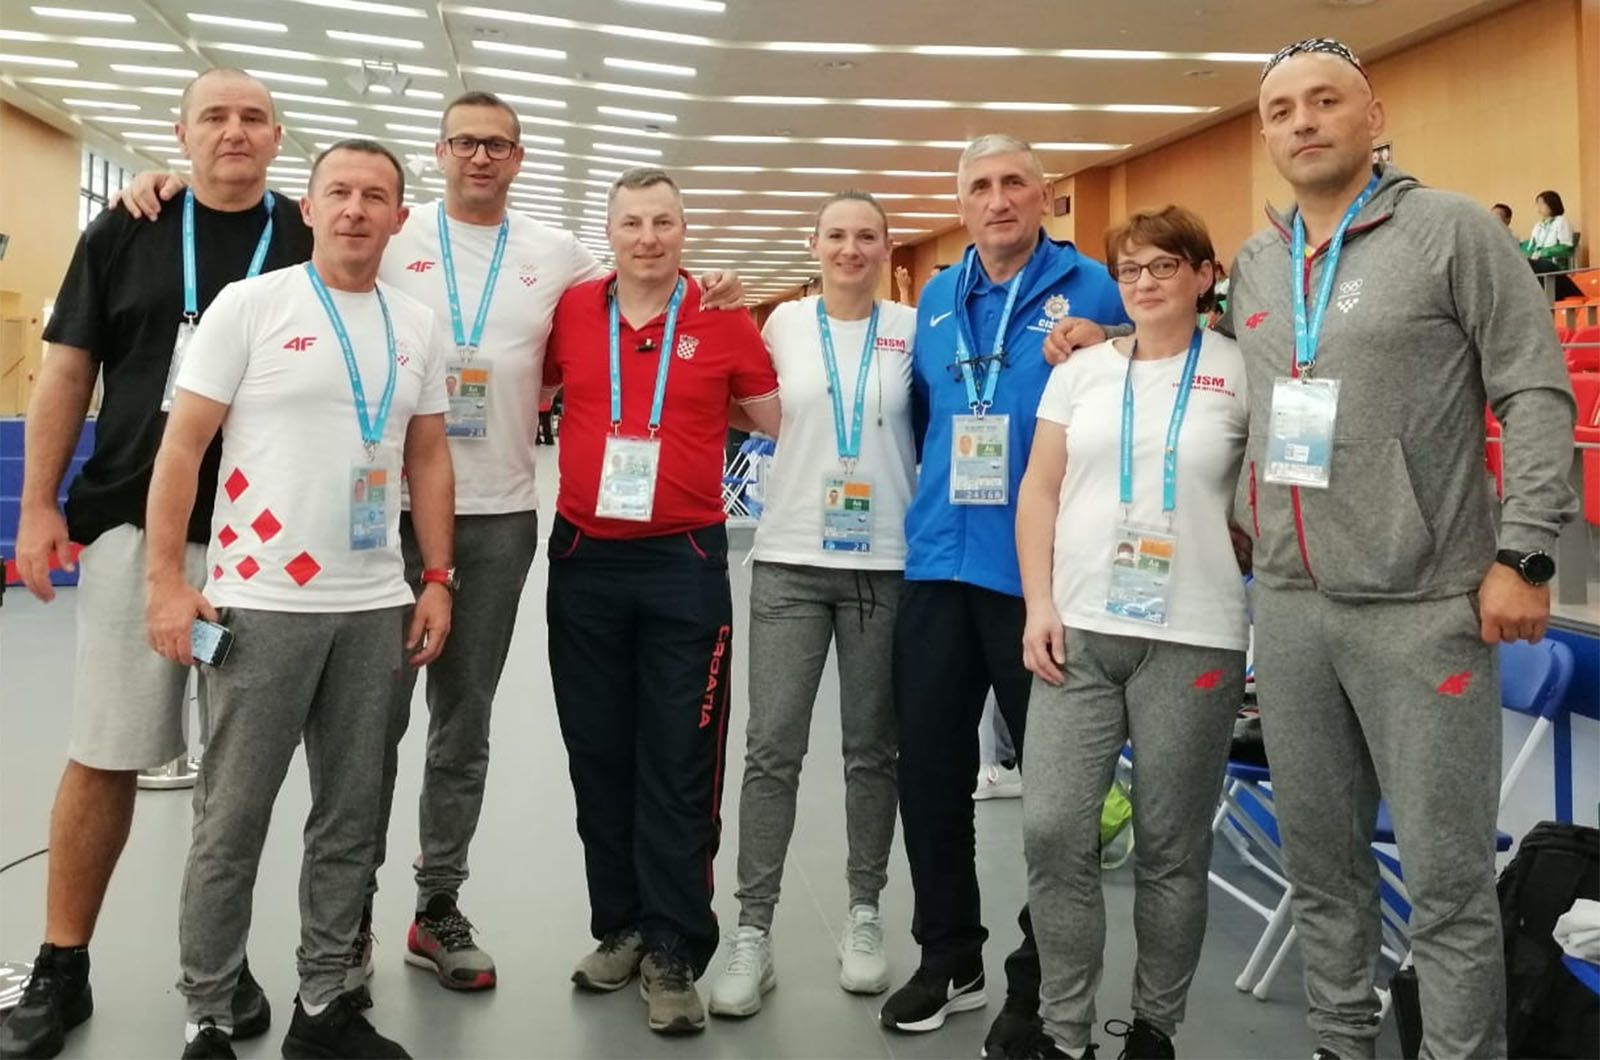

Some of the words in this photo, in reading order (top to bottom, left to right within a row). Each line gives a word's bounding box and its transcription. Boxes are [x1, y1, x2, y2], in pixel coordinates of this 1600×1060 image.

[406, 261, 435, 272] 4F
[283, 337, 317, 351] 4F
[877, 337, 906, 349] CISM
[698, 624, 731, 729] CROATIA
[1435, 670, 1474, 697] 4F
